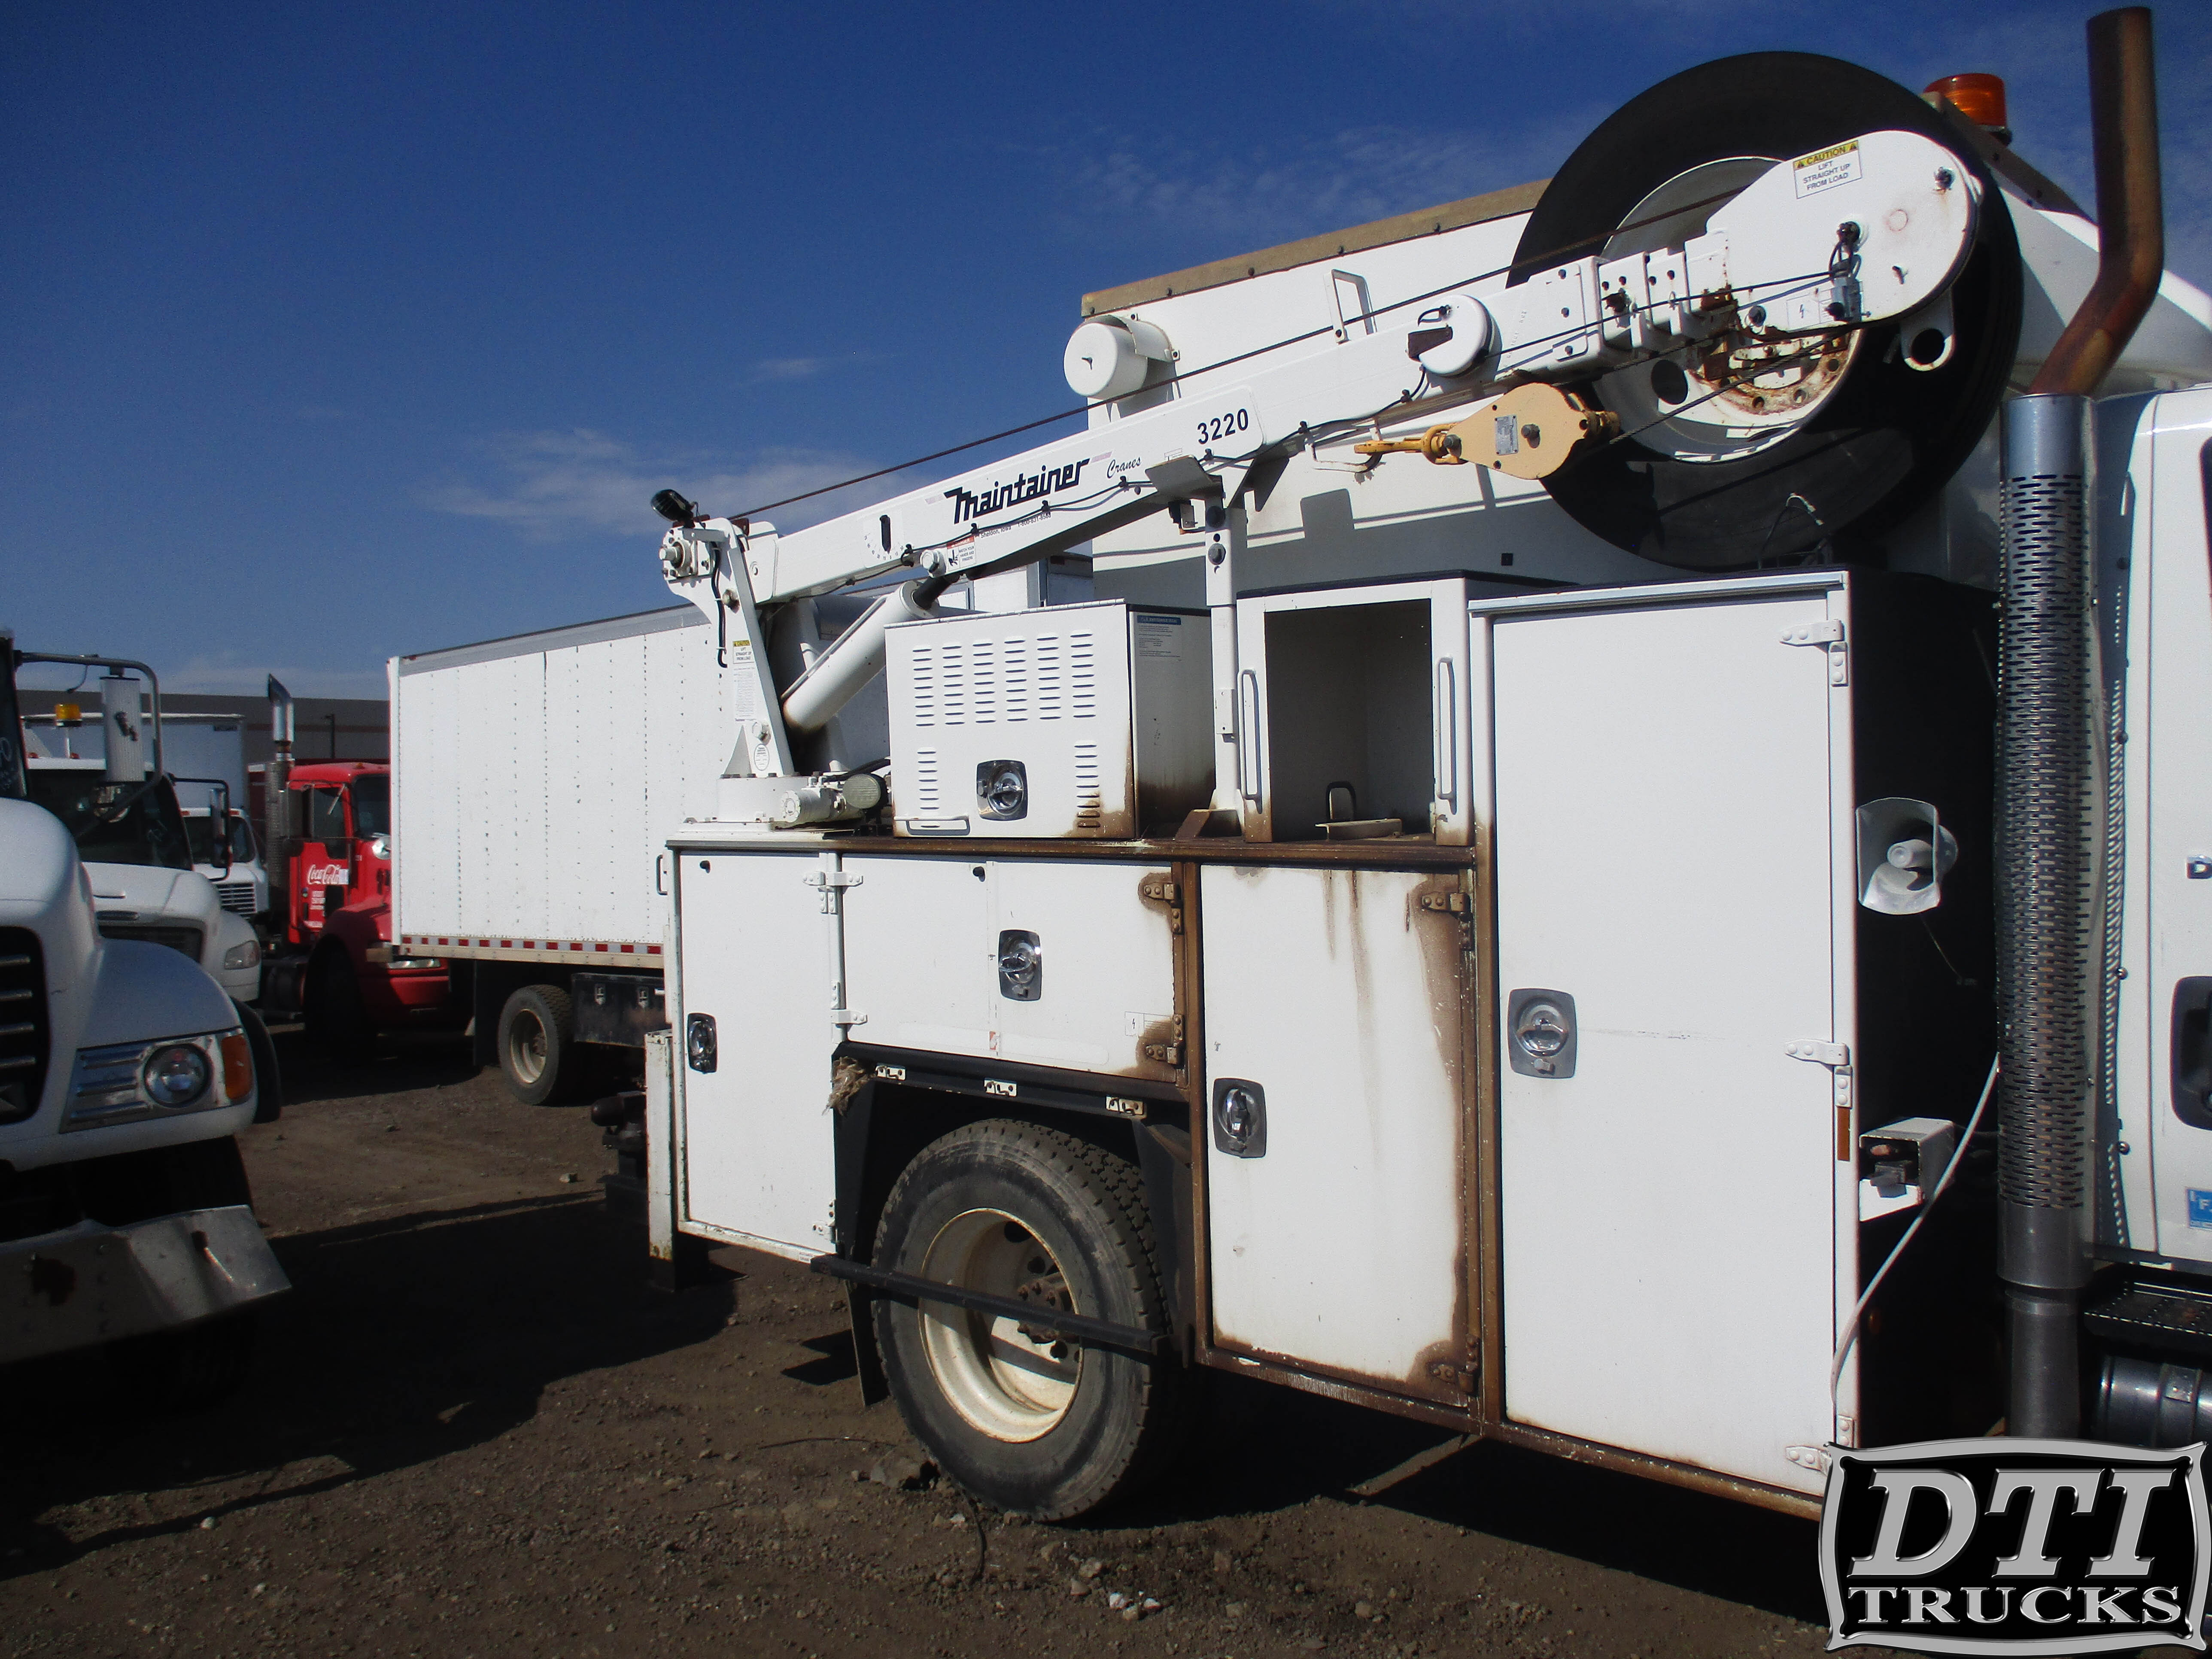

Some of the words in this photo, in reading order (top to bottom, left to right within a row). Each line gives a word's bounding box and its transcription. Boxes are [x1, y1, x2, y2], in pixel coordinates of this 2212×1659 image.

[1806, 146, 1846, 165] CAUTION
[1818, 160, 1834, 170] LIFT
[1803, 167, 1838, 184] STRAIGHT
[1840, 163, 1850, 171] UP
[1806, 179, 1827, 191] FROM
[1829, 172, 1849, 183] LOAD
[1197, 408, 1249, 445] 3220
[943, 458, 1091, 525] Maintainer
[1106, 456, 1142, 478] Cranes
